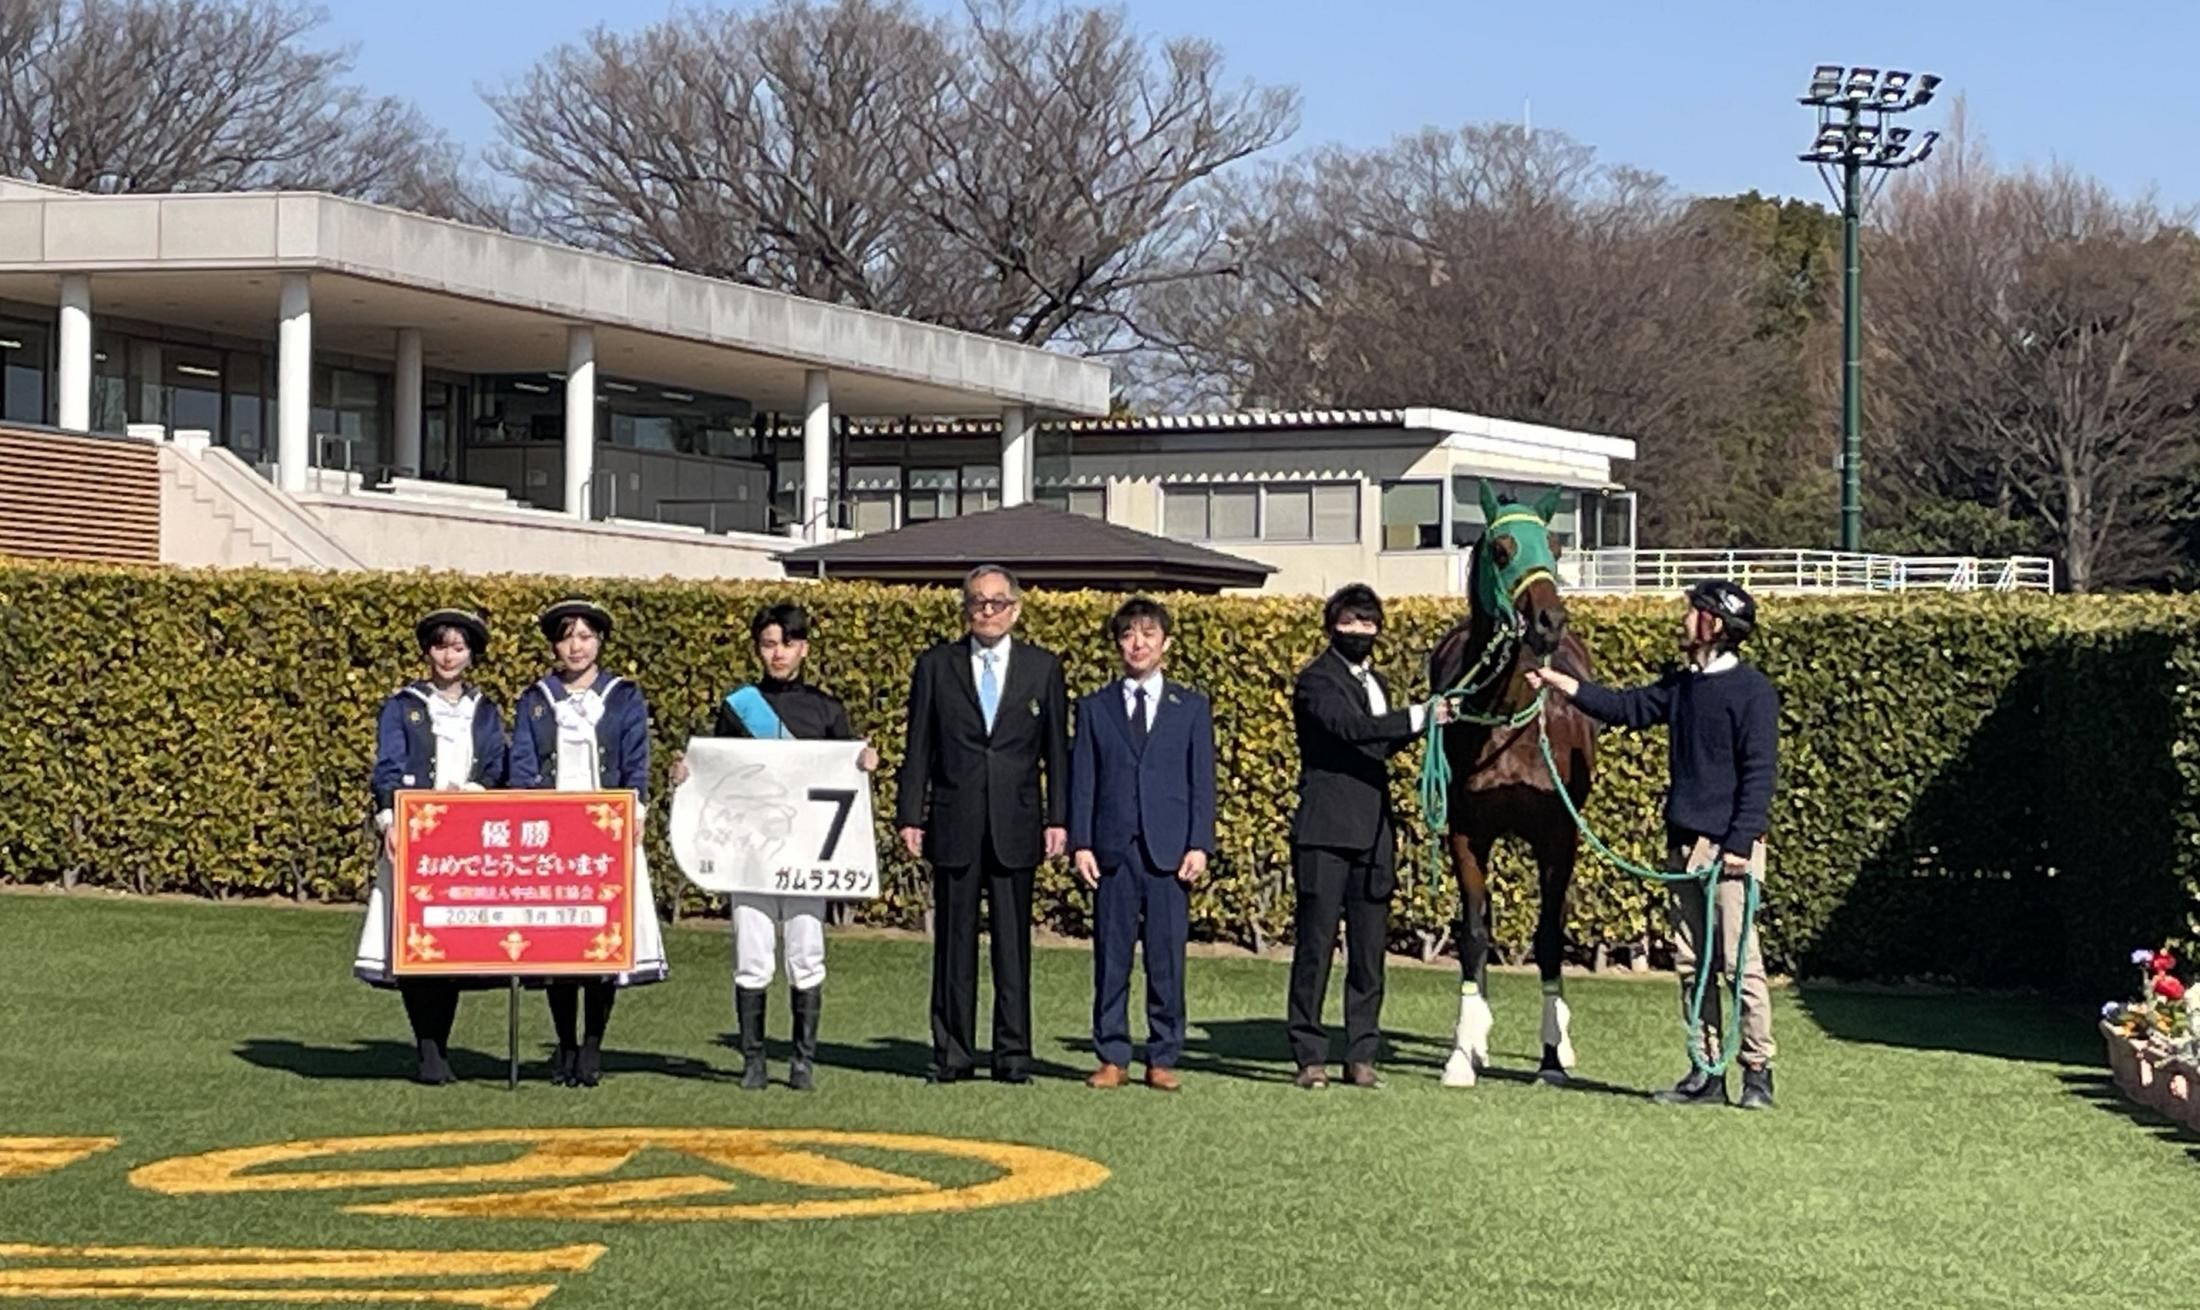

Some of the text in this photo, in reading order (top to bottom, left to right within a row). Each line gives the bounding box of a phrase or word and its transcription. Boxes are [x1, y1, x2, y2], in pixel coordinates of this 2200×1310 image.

[481, 819, 551, 849] 優勝
[807, 788, 858, 862] 7
[416, 853, 616, 878] おめでとうございます
[775, 866, 874, 892] ガムラスタン
